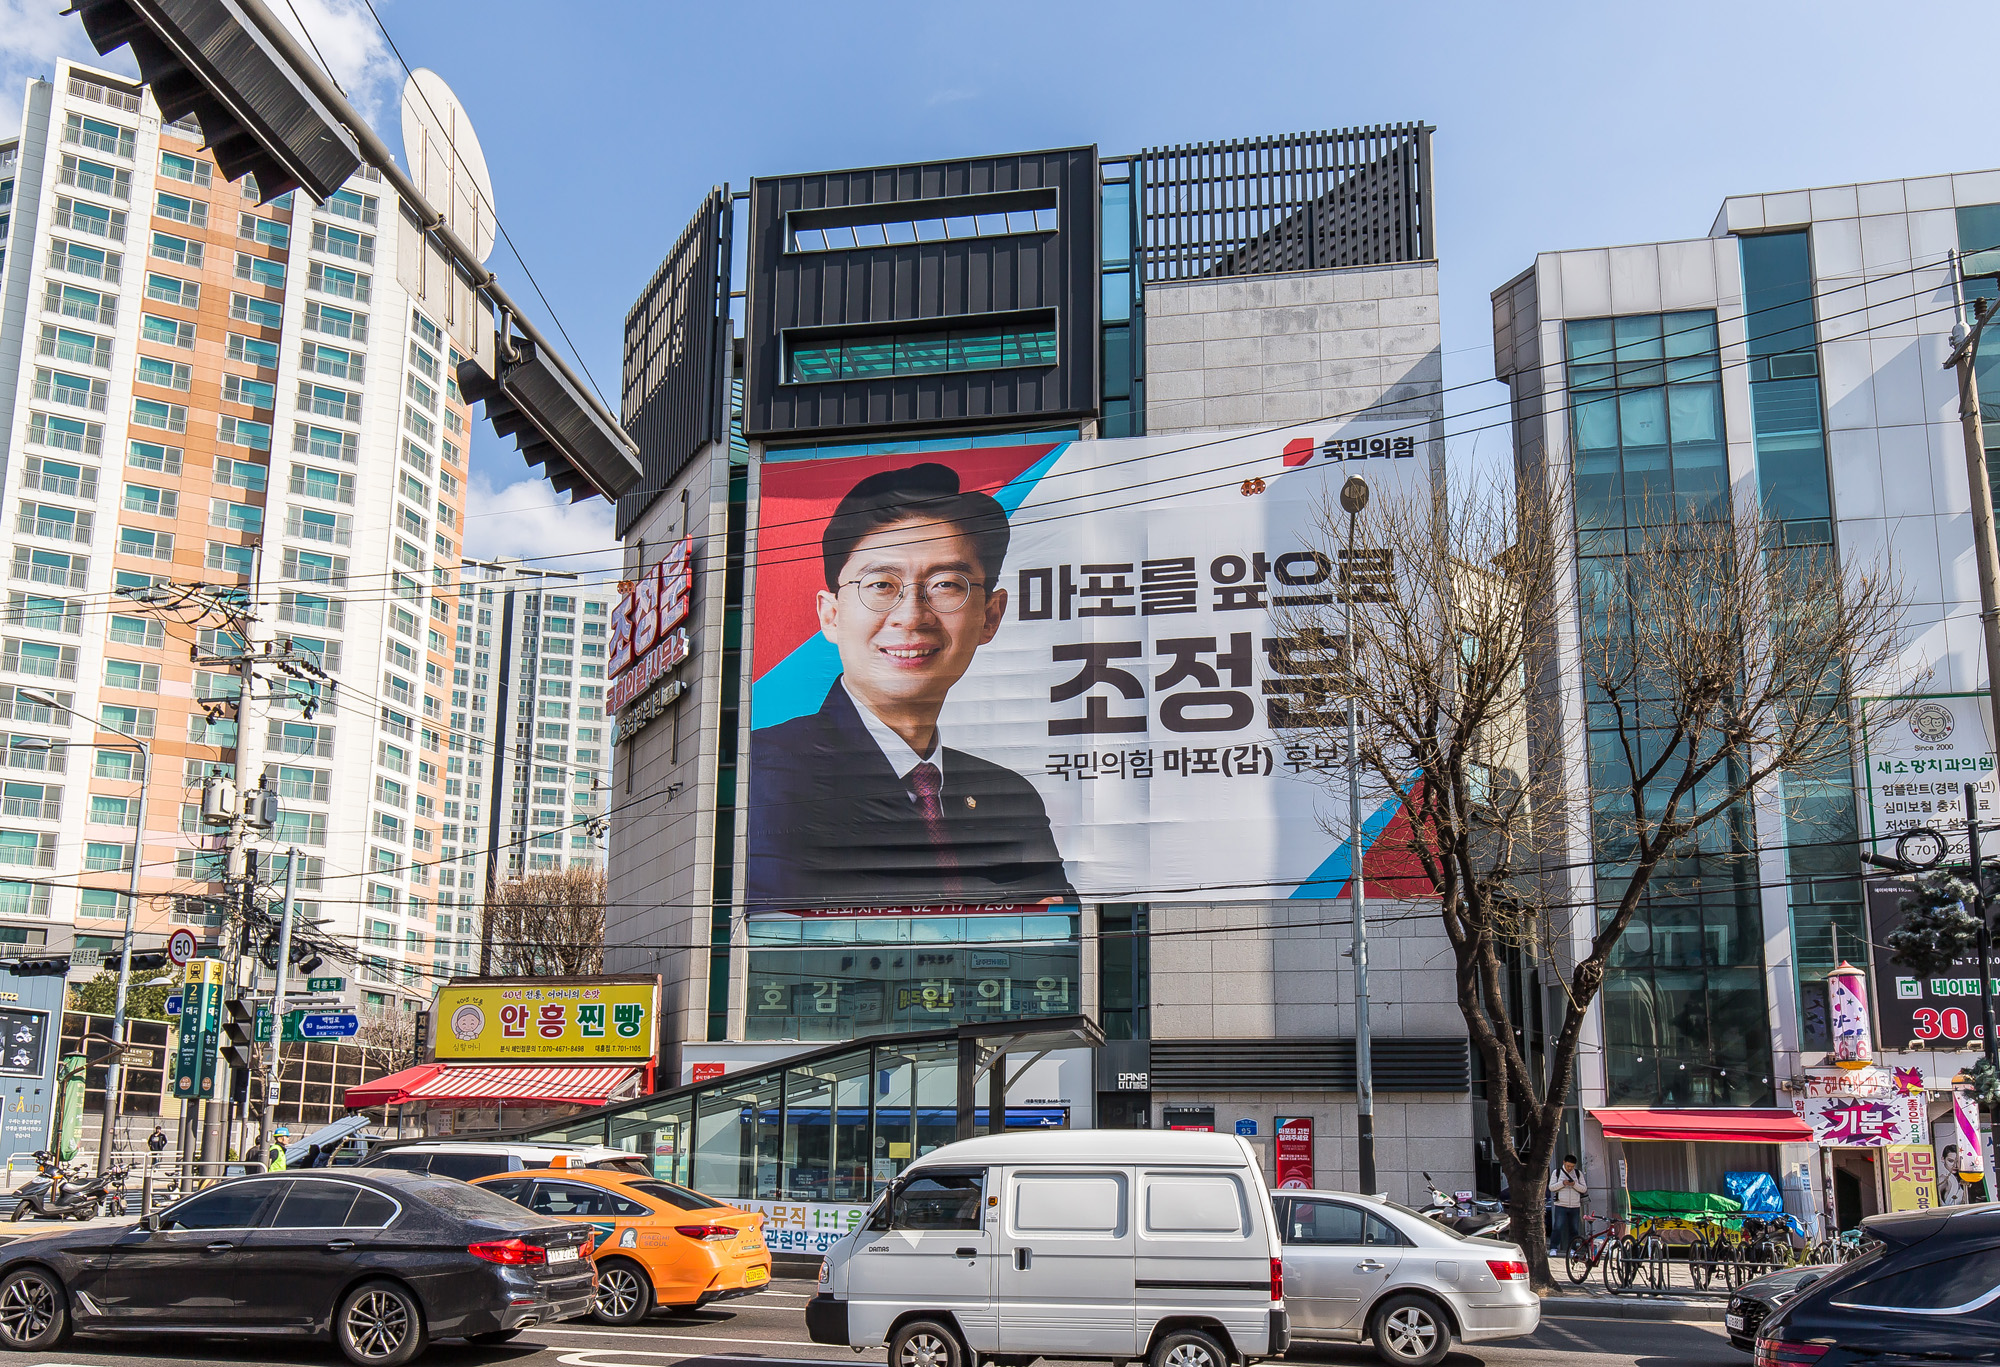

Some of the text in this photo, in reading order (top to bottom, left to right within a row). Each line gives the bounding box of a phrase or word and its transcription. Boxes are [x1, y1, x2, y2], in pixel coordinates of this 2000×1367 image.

[1322, 436, 1414, 461] 국민의힘
[1018, 547, 1396, 621] 마포를 앞으로
[608, 533, 692, 680] 조정훈
[606, 657, 649, 716] 국회의원
[649, 627, 688, 683] 사무소
[1045, 747, 1154, 781] 국민의힘
[1163, 745, 1274, 778] 마포(갑)
[1877, 757, 1994, 774] 새소망치과의원
[1882, 782, 1959, 796] 임플란트(경력
[1884, 801, 1932, 814] 심미보철
[1936, 799, 1961, 813] 충치
[1926, 819, 1942, 830] CT
[175, 940, 190, 956] 50
[190, 985, 198, 996] 2
[212, 986, 218, 997] 2
[312, 980, 337, 989] 대흥역
[502, 989, 522, 1000] 40년
[547, 989, 580, 1000] 어머니의
[582, 989, 601, 1000] 손맛
[499, 1002, 645, 1039] 안흥찐빵
[1118, 1073, 1148, 1081] DANA
[271, 1089, 278, 1097] 95
[8, 1097, 44, 1113] GAUDI
[1834, 1110, 1884, 1134] 기분
[1278, 1127, 1310, 1135] 마포의 고민
[1279, 1134, 1309, 1142] 알려주세요
[1888, 1152, 1934, 1183] 뒷문
[813, 1209, 839, 1230] 1:1
